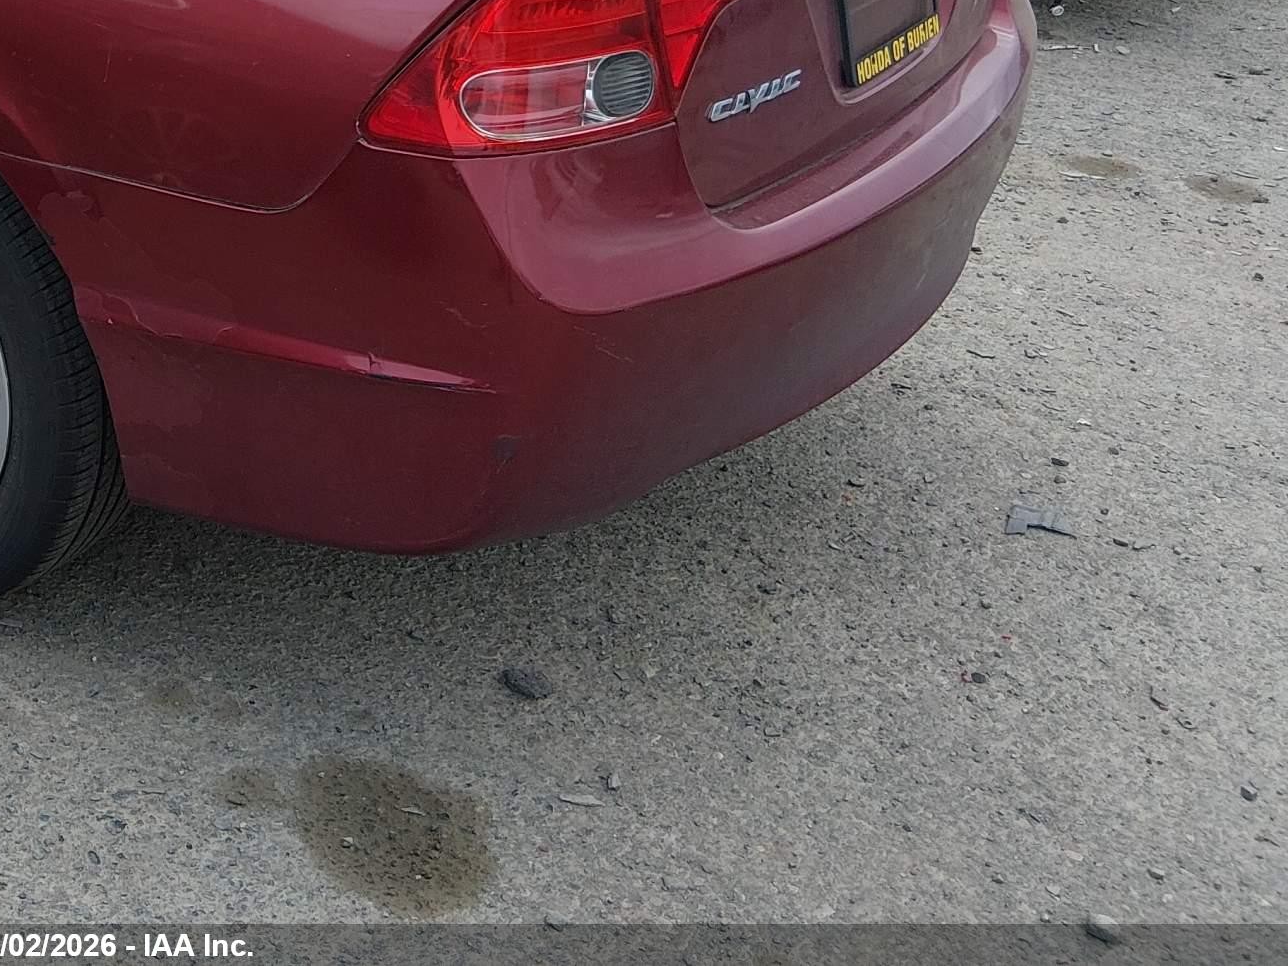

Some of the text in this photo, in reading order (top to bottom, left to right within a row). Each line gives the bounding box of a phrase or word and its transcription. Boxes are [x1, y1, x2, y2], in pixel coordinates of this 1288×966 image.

[856, 13, 940, 85] HONDA OF BURIEN
[709, 68, 802, 122] CIVIC
